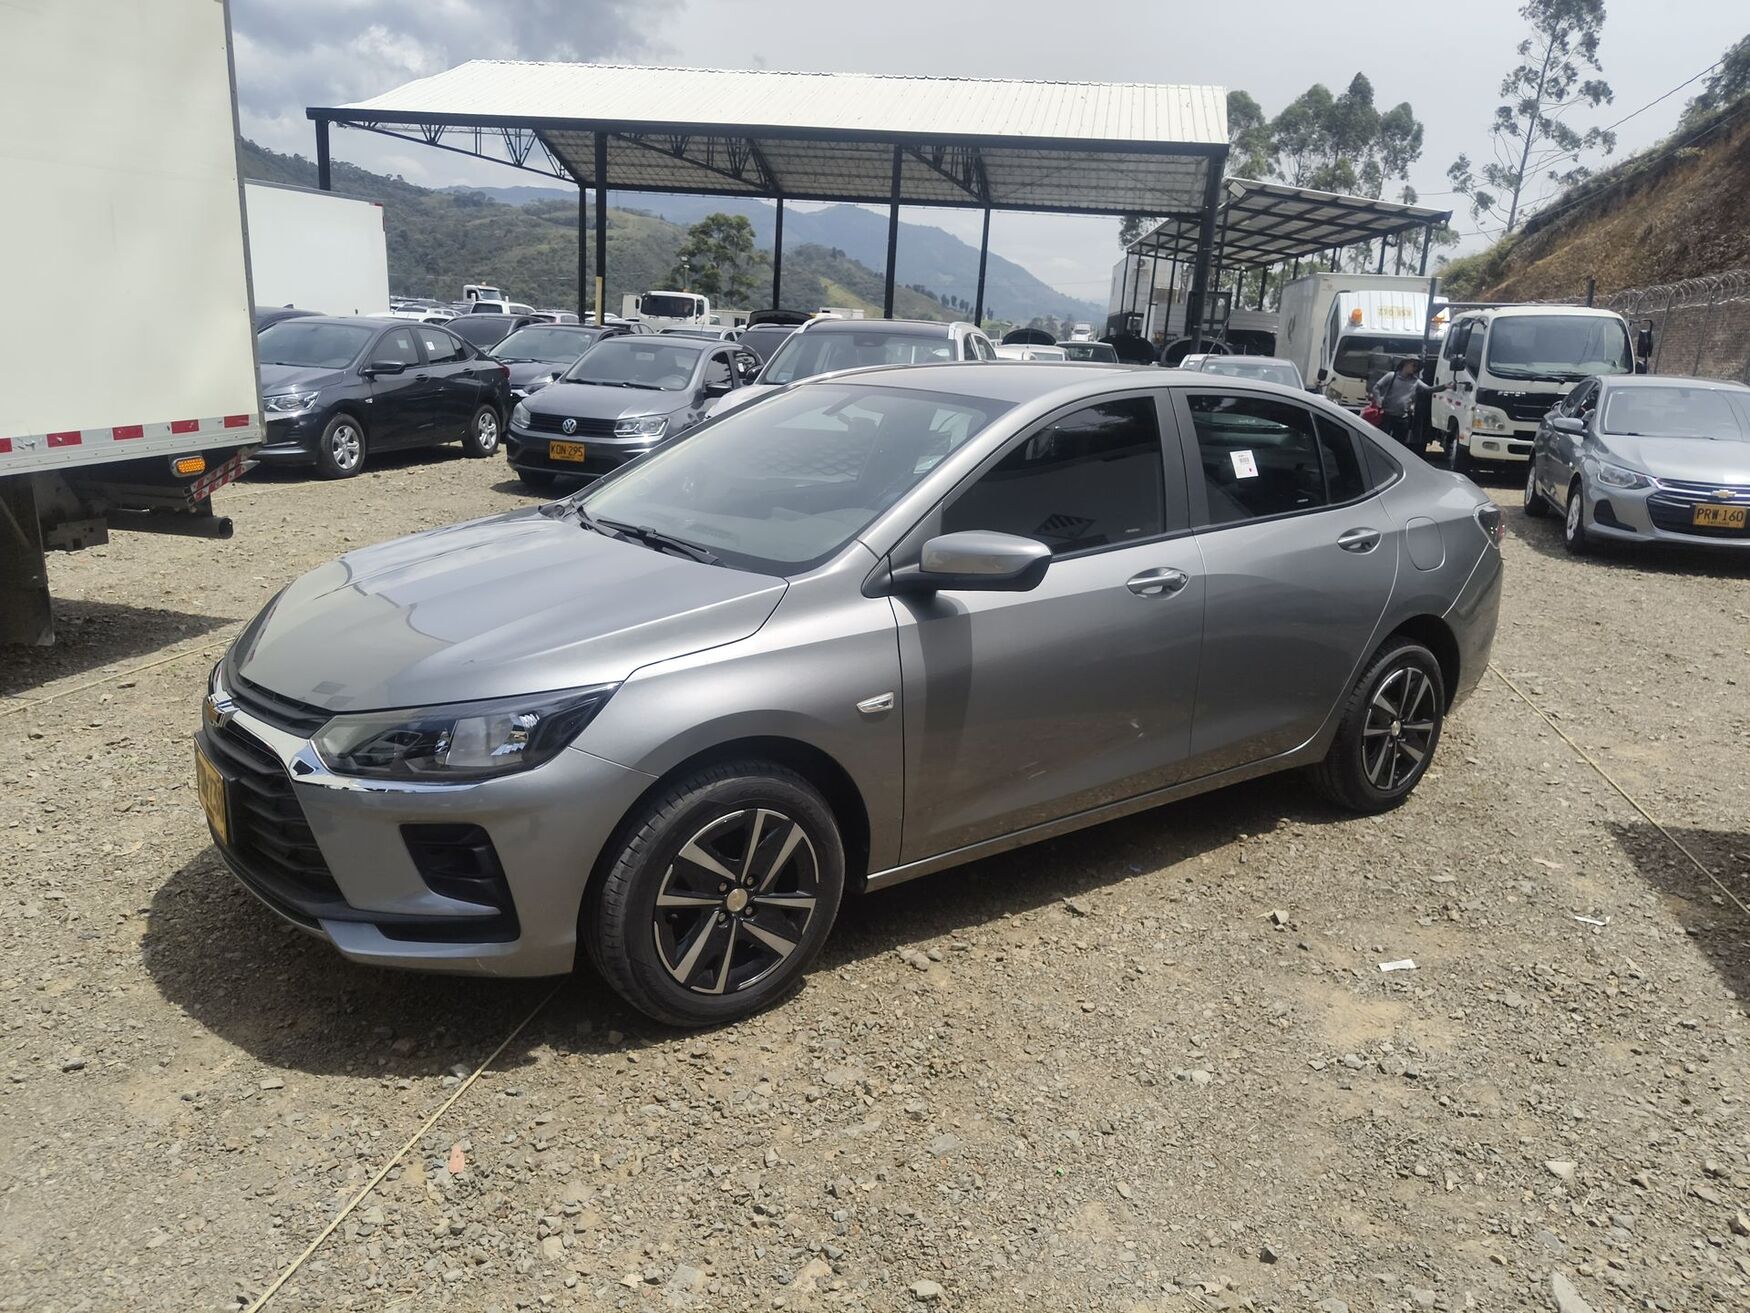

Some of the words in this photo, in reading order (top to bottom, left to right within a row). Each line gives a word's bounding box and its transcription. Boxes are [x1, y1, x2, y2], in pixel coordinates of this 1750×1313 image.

[568, 445, 583, 457] 295
[1696, 508, 1719, 520] PRW
[1722, 509, 1744, 522] 160
